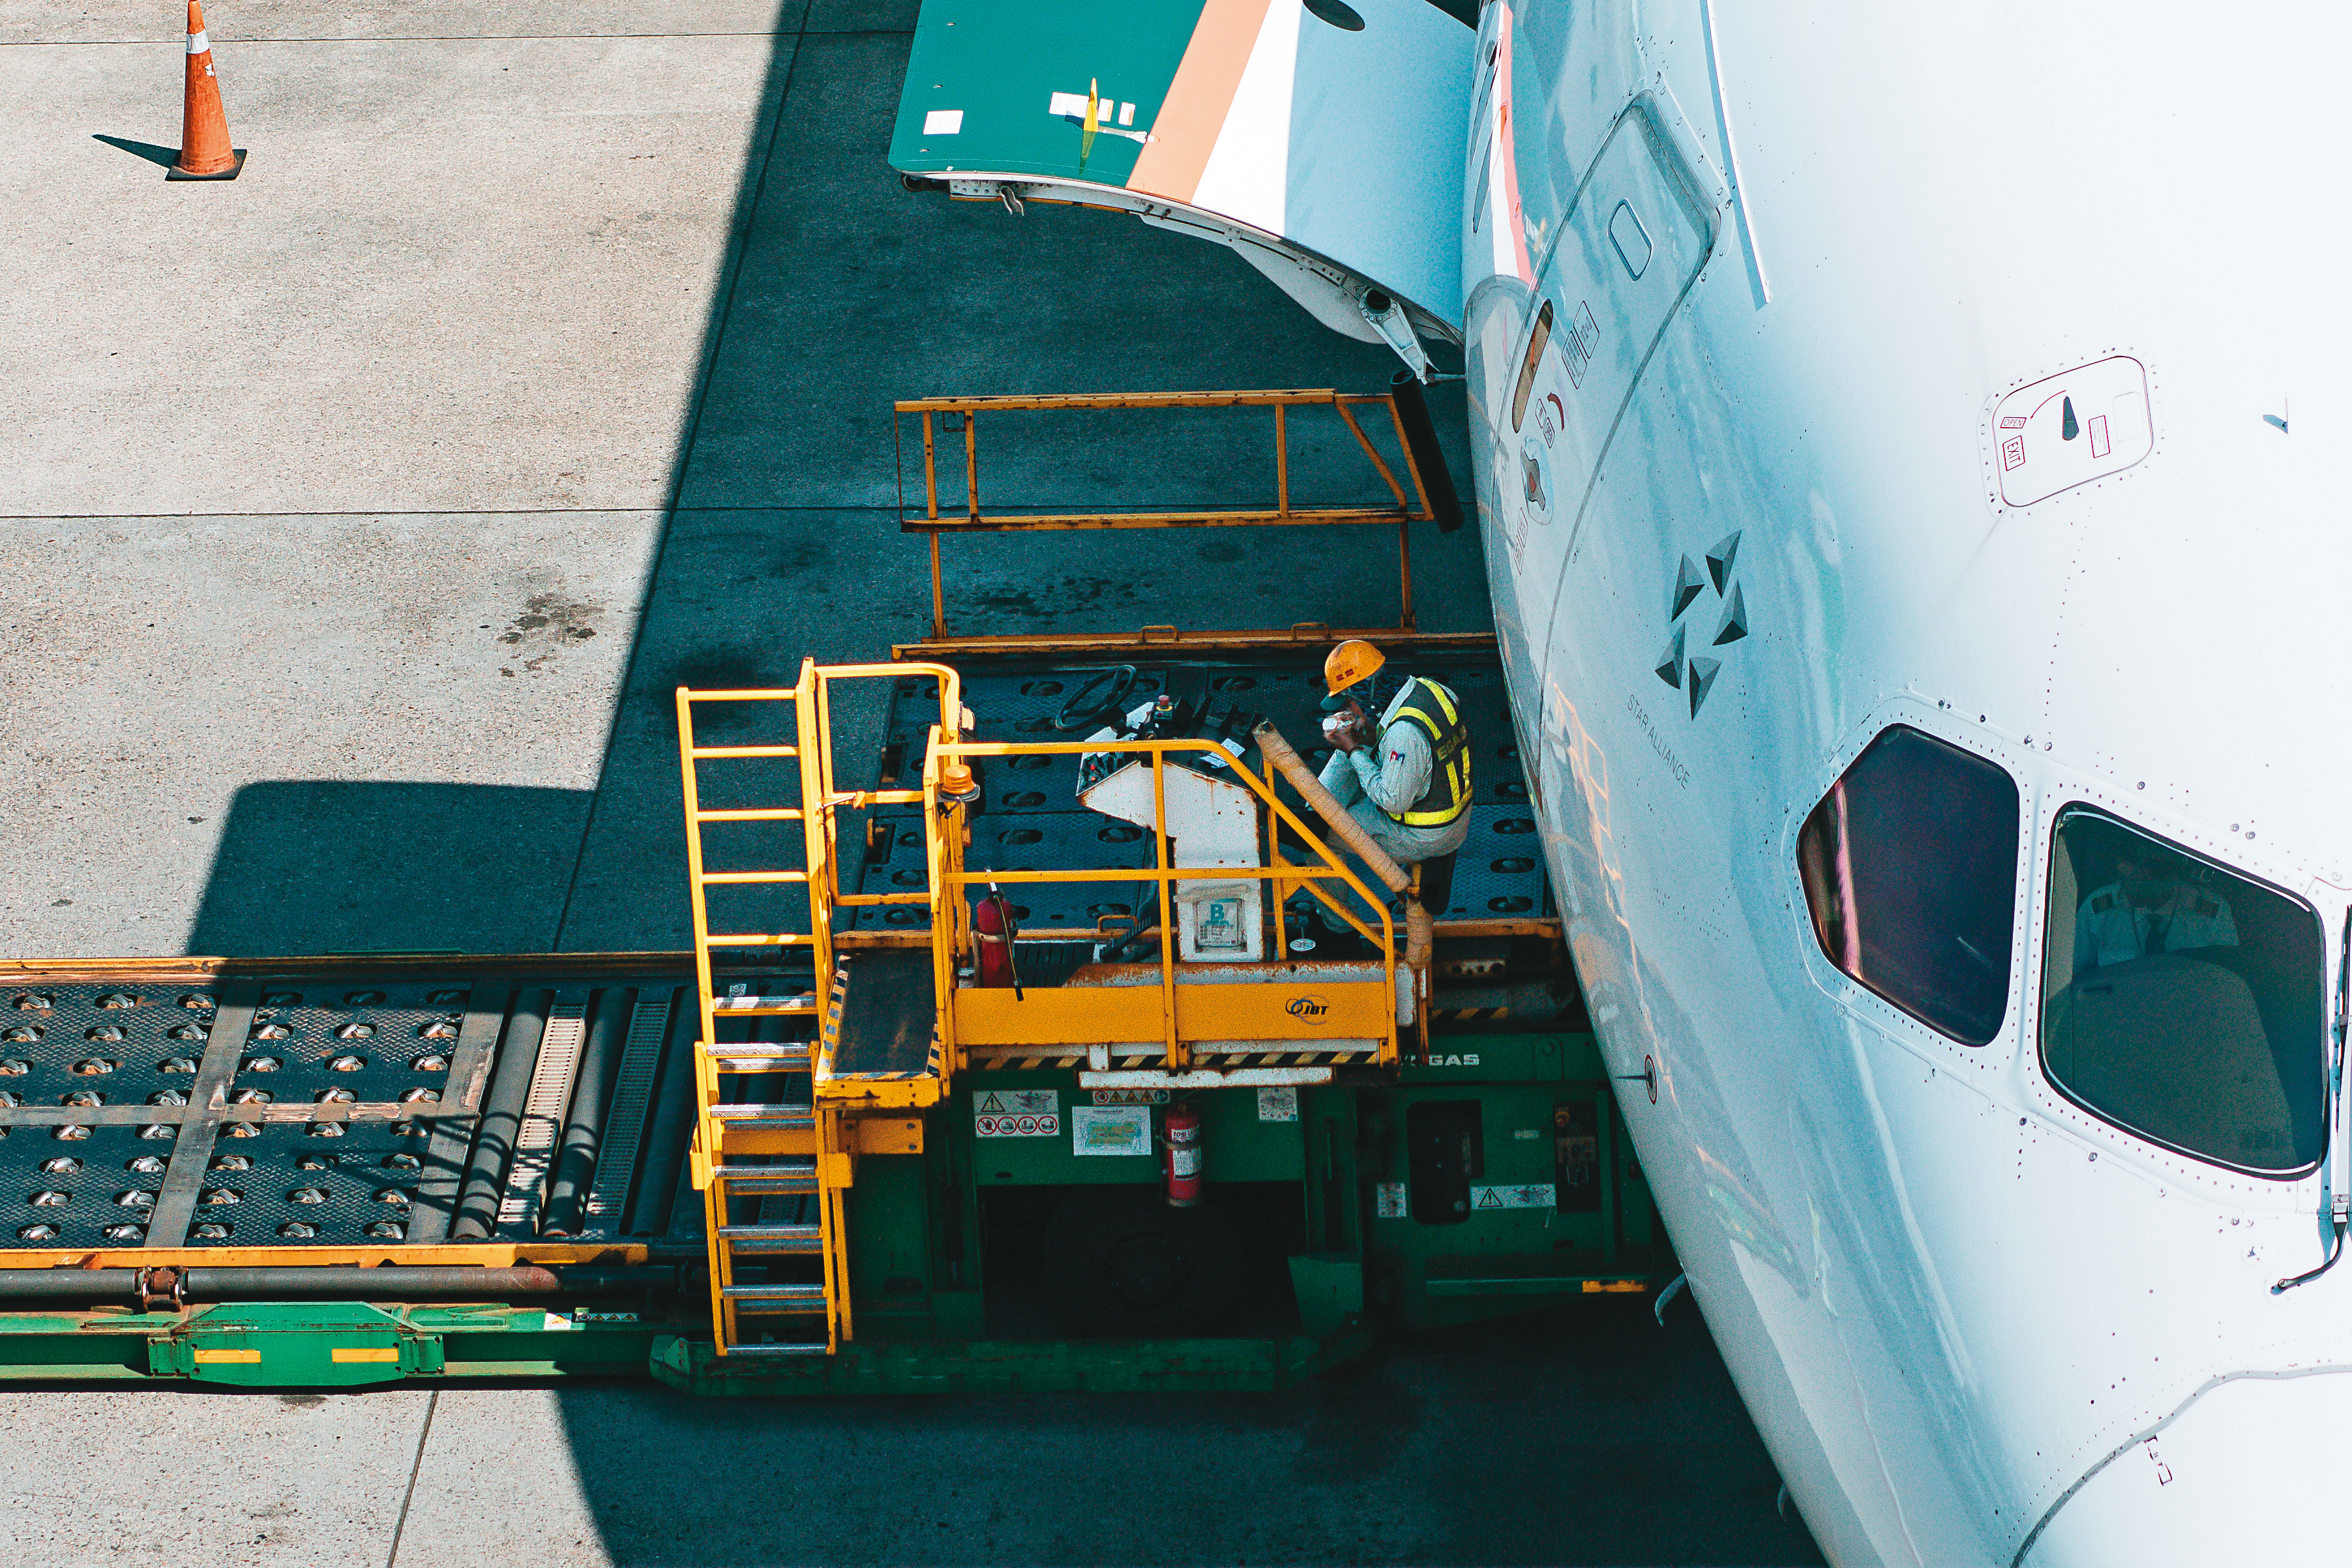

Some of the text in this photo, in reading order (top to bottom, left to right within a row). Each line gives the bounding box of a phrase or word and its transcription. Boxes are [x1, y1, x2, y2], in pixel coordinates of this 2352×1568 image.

[2003, 419, 2024, 427] OPEN
[2007, 441, 2021, 463] EXIT
[1627, 694, 1690, 790] STAR ALLIANCE
[1302, 1005, 1330, 1015] JBT
